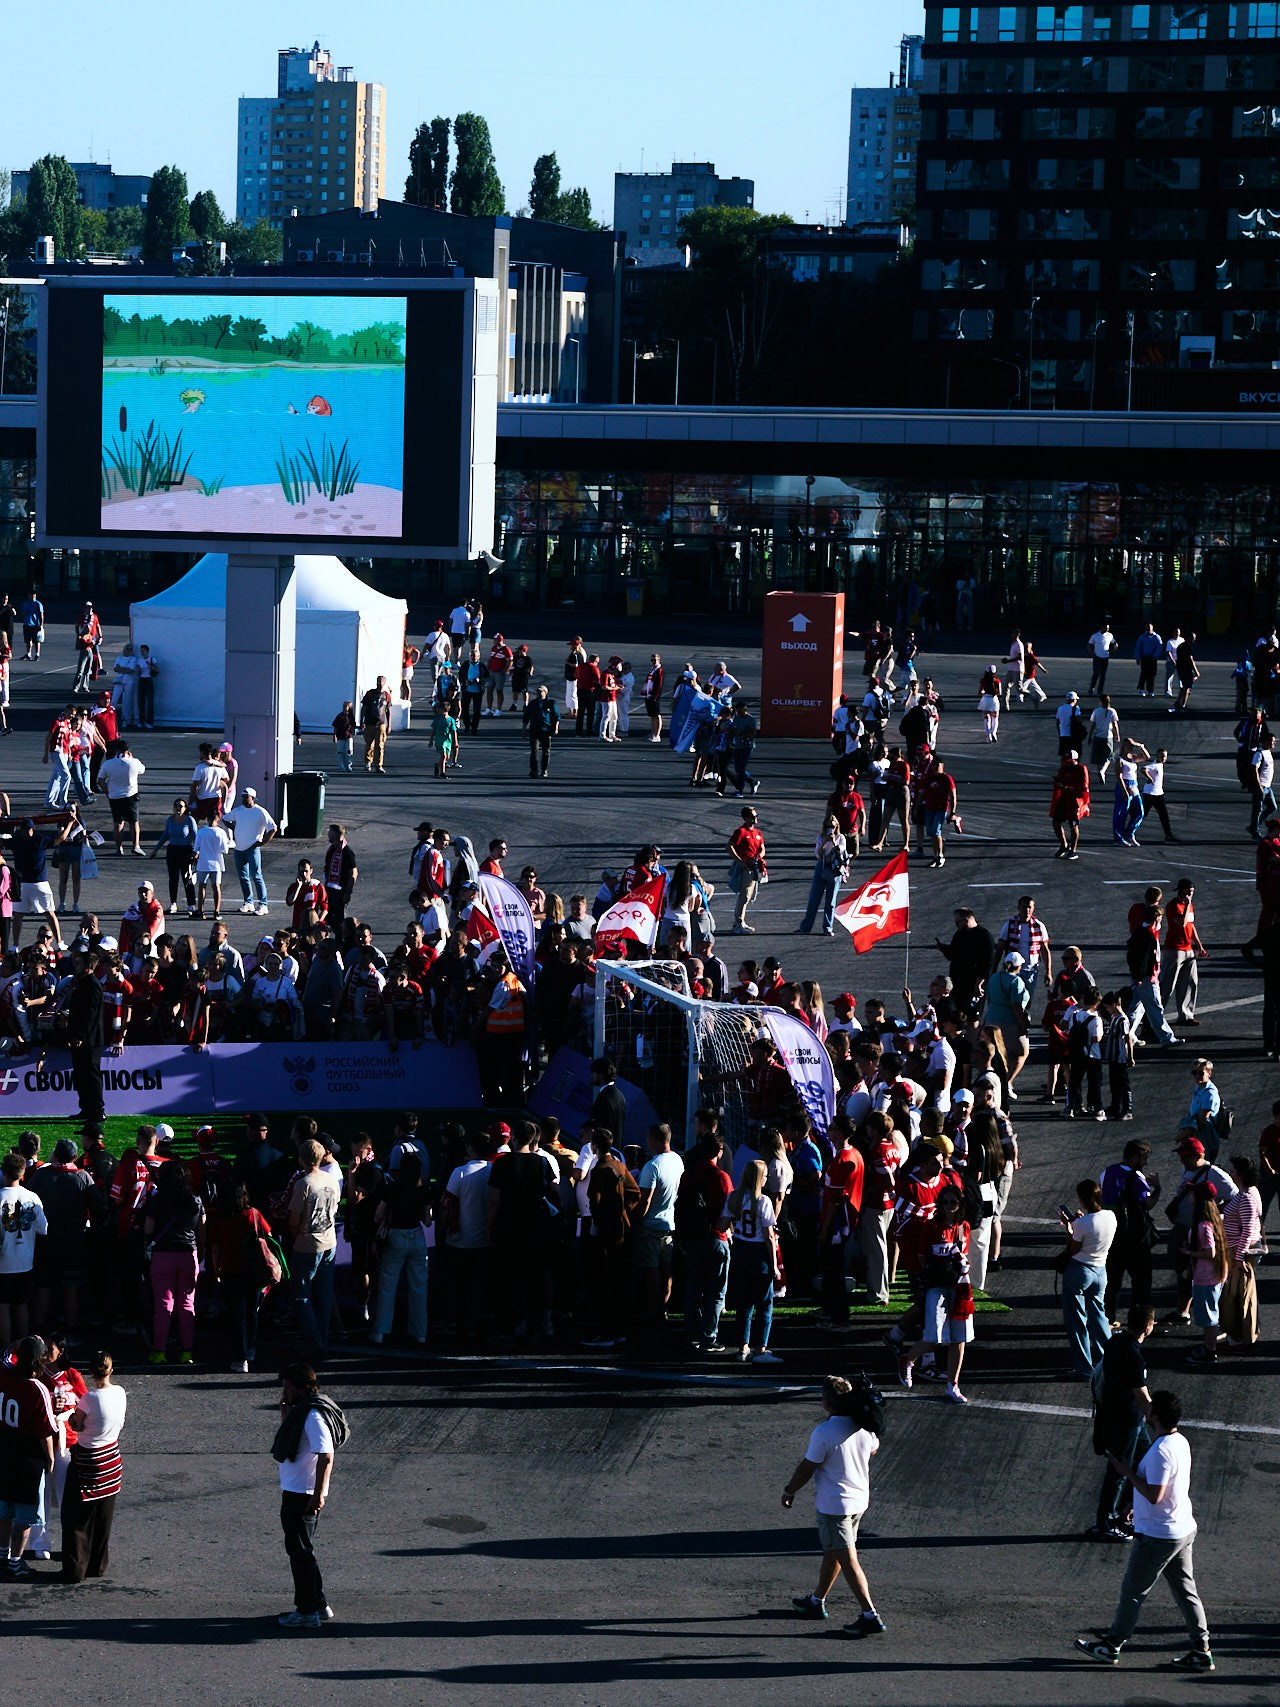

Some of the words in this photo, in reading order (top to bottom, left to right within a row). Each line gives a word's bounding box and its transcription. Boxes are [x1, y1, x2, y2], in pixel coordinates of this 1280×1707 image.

[780, 642, 818, 651] ВЫХОД
[771, 698, 823, 707] OLIMPBET
[794, 1048, 812, 1057] СВОИ
[325, 1056, 400, 1067] РОССИЙСКИЙ
[326, 1068, 406, 1080] ФУТБОЛЬНЫЙ
[101, 1069, 162, 1091] ЛЮСЫ
[328, 1082, 360, 1092] СОЮЗ
